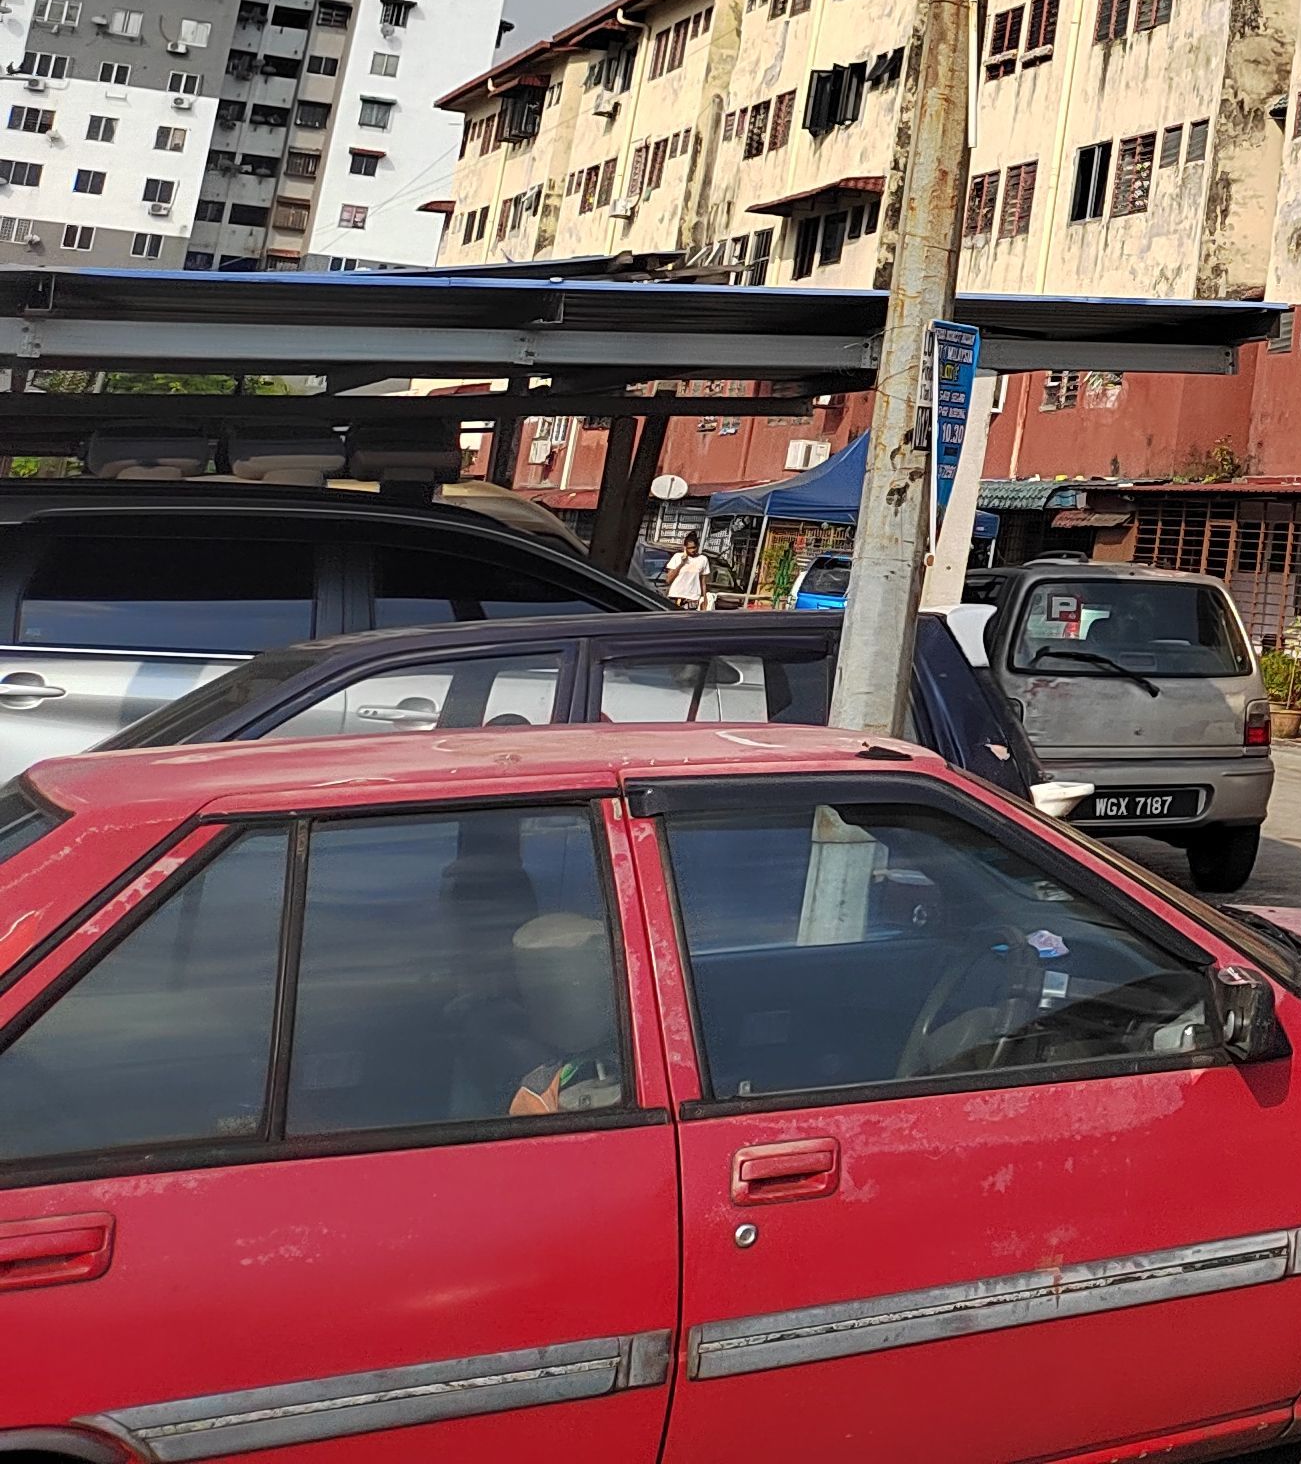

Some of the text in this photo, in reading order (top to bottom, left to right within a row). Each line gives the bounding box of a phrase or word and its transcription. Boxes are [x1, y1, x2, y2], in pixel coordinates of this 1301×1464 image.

[1051, 596, 1078, 619] P
[1095, 795, 1173, 816] WGX 7187
